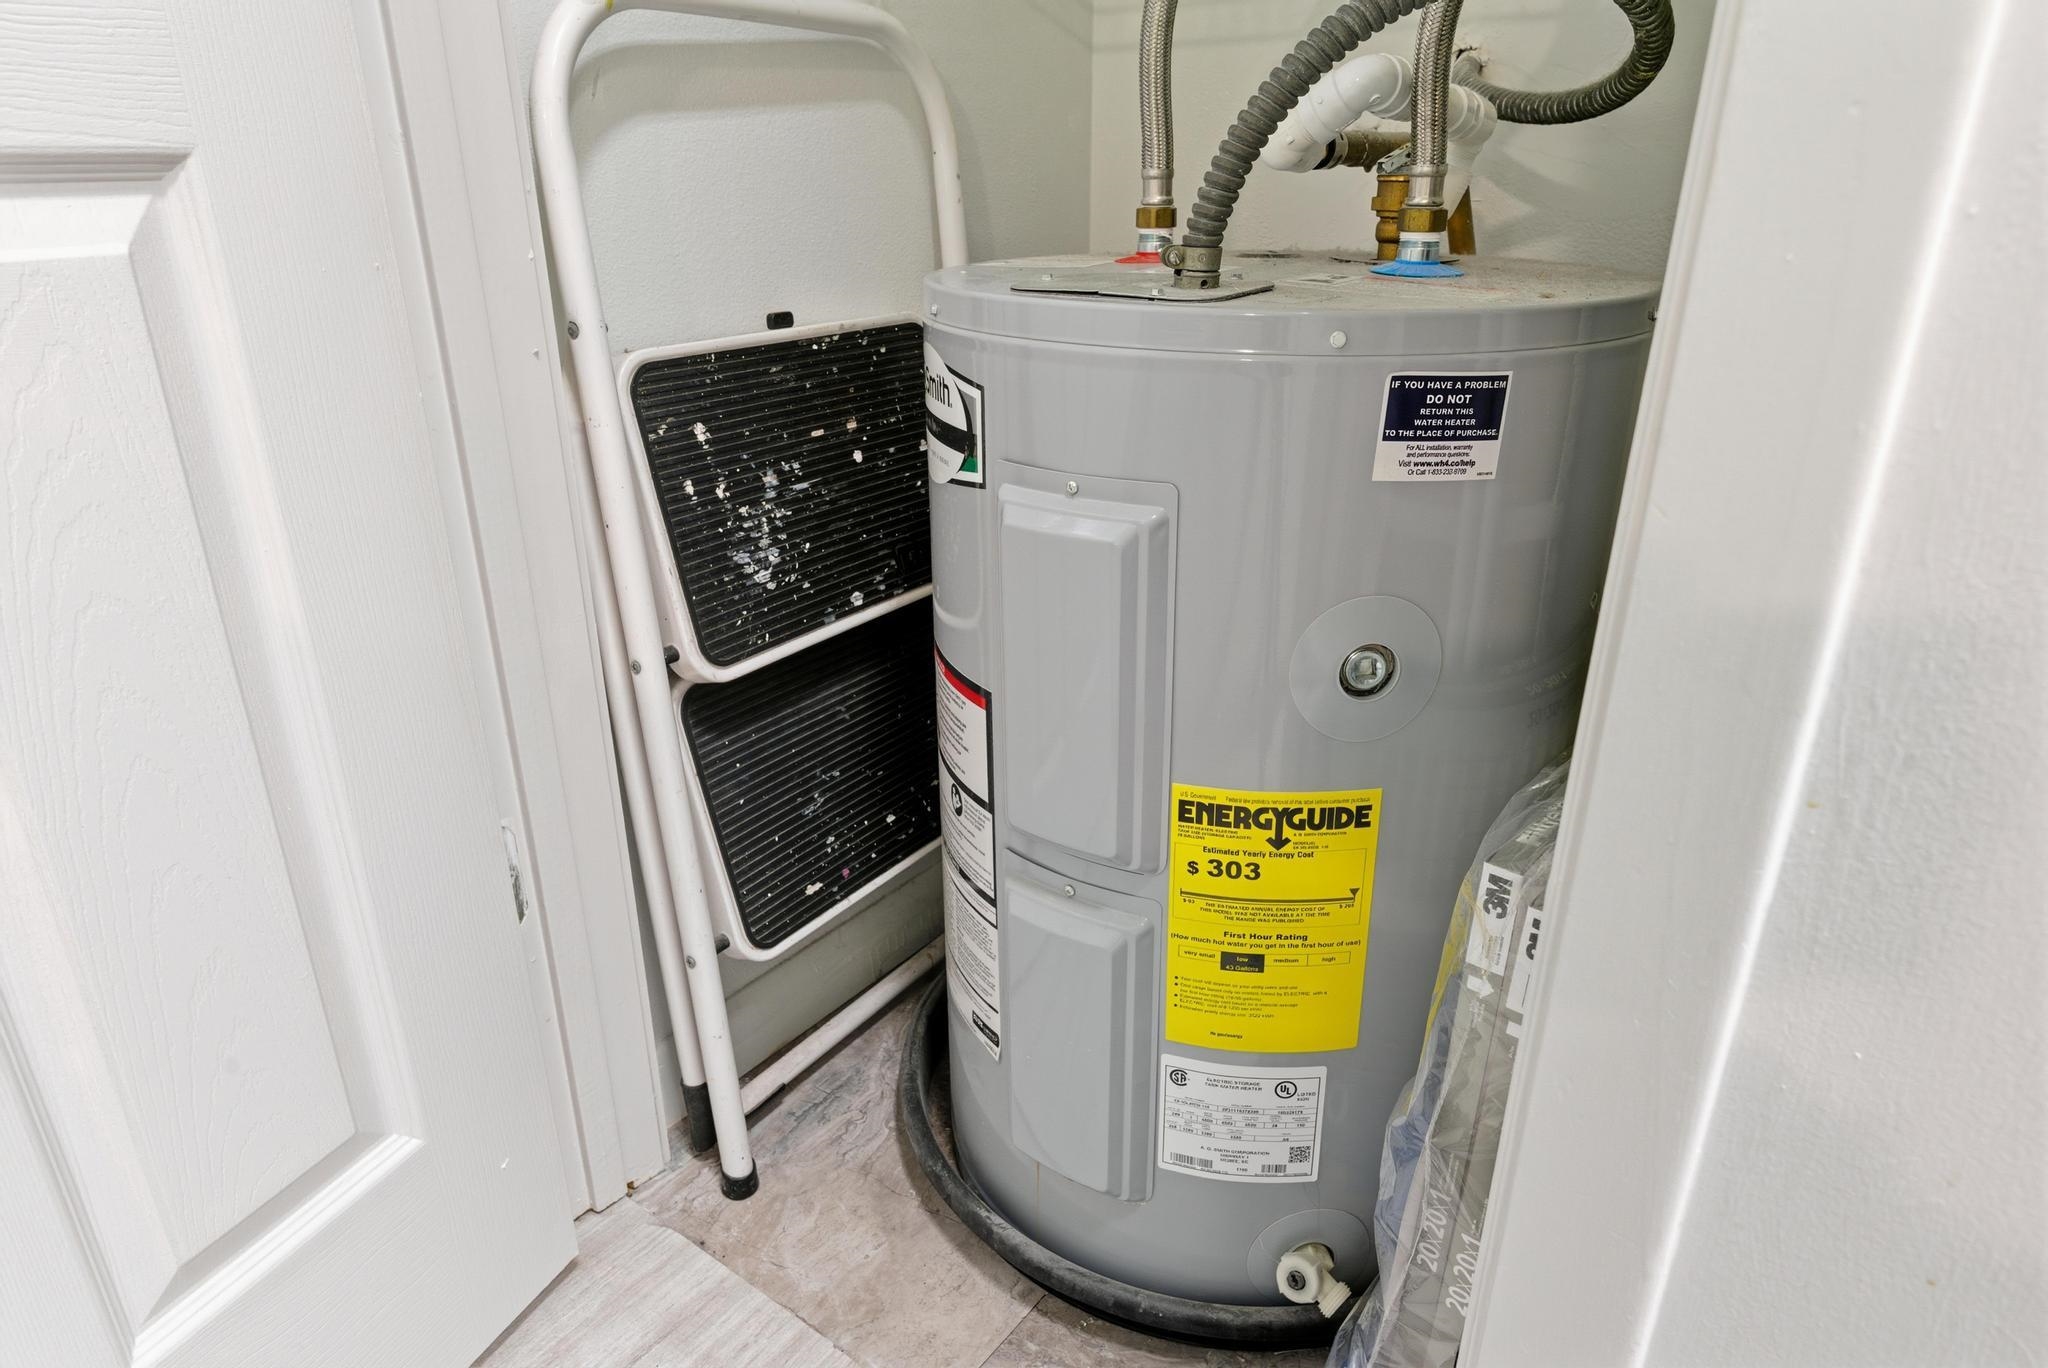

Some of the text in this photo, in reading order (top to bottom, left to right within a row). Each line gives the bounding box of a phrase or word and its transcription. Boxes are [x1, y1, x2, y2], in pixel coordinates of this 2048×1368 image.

[1391, 380, 1507, 389] IF YOU HAVE A PROBLEM
[1426, 394, 1472, 404] DO NOT
[1178, 799, 1372, 832] ENERGYGUIDE
[1203, 846, 1314, 859] Estimated Yearly Energy Cost
[1187, 859, 1262, 881] $ 303
[1483, 873, 1513, 920] 3M
[1170, 932, 1189, 941] (How
[1191, 935, 1211, 944] much
[1212, 938, 1226, 946] hot
[1227, 940, 1247, 948] water
[1265, 942, 1277, 950] get
[1301, 941, 1316, 949] first
[1318, 940, 1335, 948] hour
[1223, 931, 1309, 942] First Hour Rating
[1236, 955, 1249, 963] low
[1416, 1188, 1450, 1273] 20x20x1
